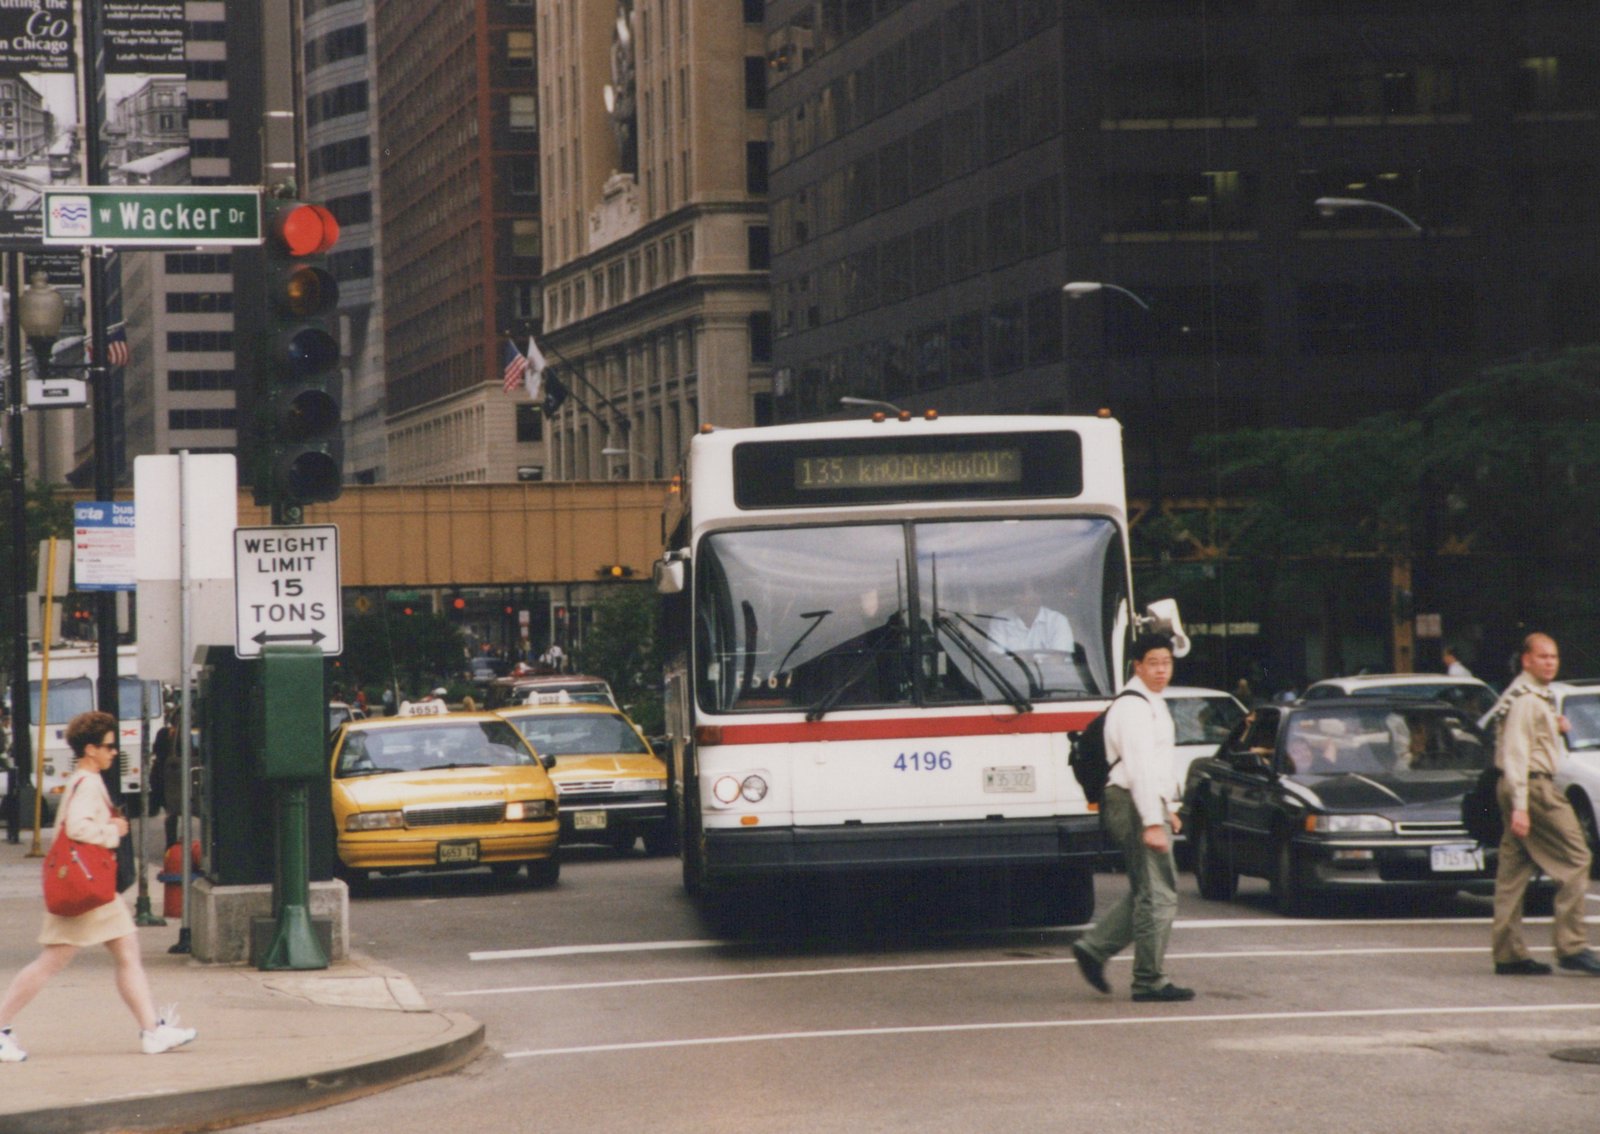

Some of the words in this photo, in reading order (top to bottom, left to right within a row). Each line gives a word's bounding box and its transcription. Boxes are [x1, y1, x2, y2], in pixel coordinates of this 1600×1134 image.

[45, 0, 68, 9] the
[26, 10, 69, 38] Go
[103, 29, 130, 38] Chicago
[112, 37, 139, 46] Chicago
[12, 36, 69, 54] Chicago
[99, 208, 111, 223] W
[118, 202, 221, 230] Wacker
[228, 208, 246, 223] Dr
[803, 458, 844, 484] 135
[112, 504, 134, 514] bus
[112, 514, 136, 526] stop
[244, 536, 328, 553] WEIGHT
[258, 556, 316, 573] LIMIT
[271, 578, 304, 597] 15
[250, 602, 326, 623] TONS
[408, 705, 440, 715] 4653
[893, 750, 953, 771] 4196
